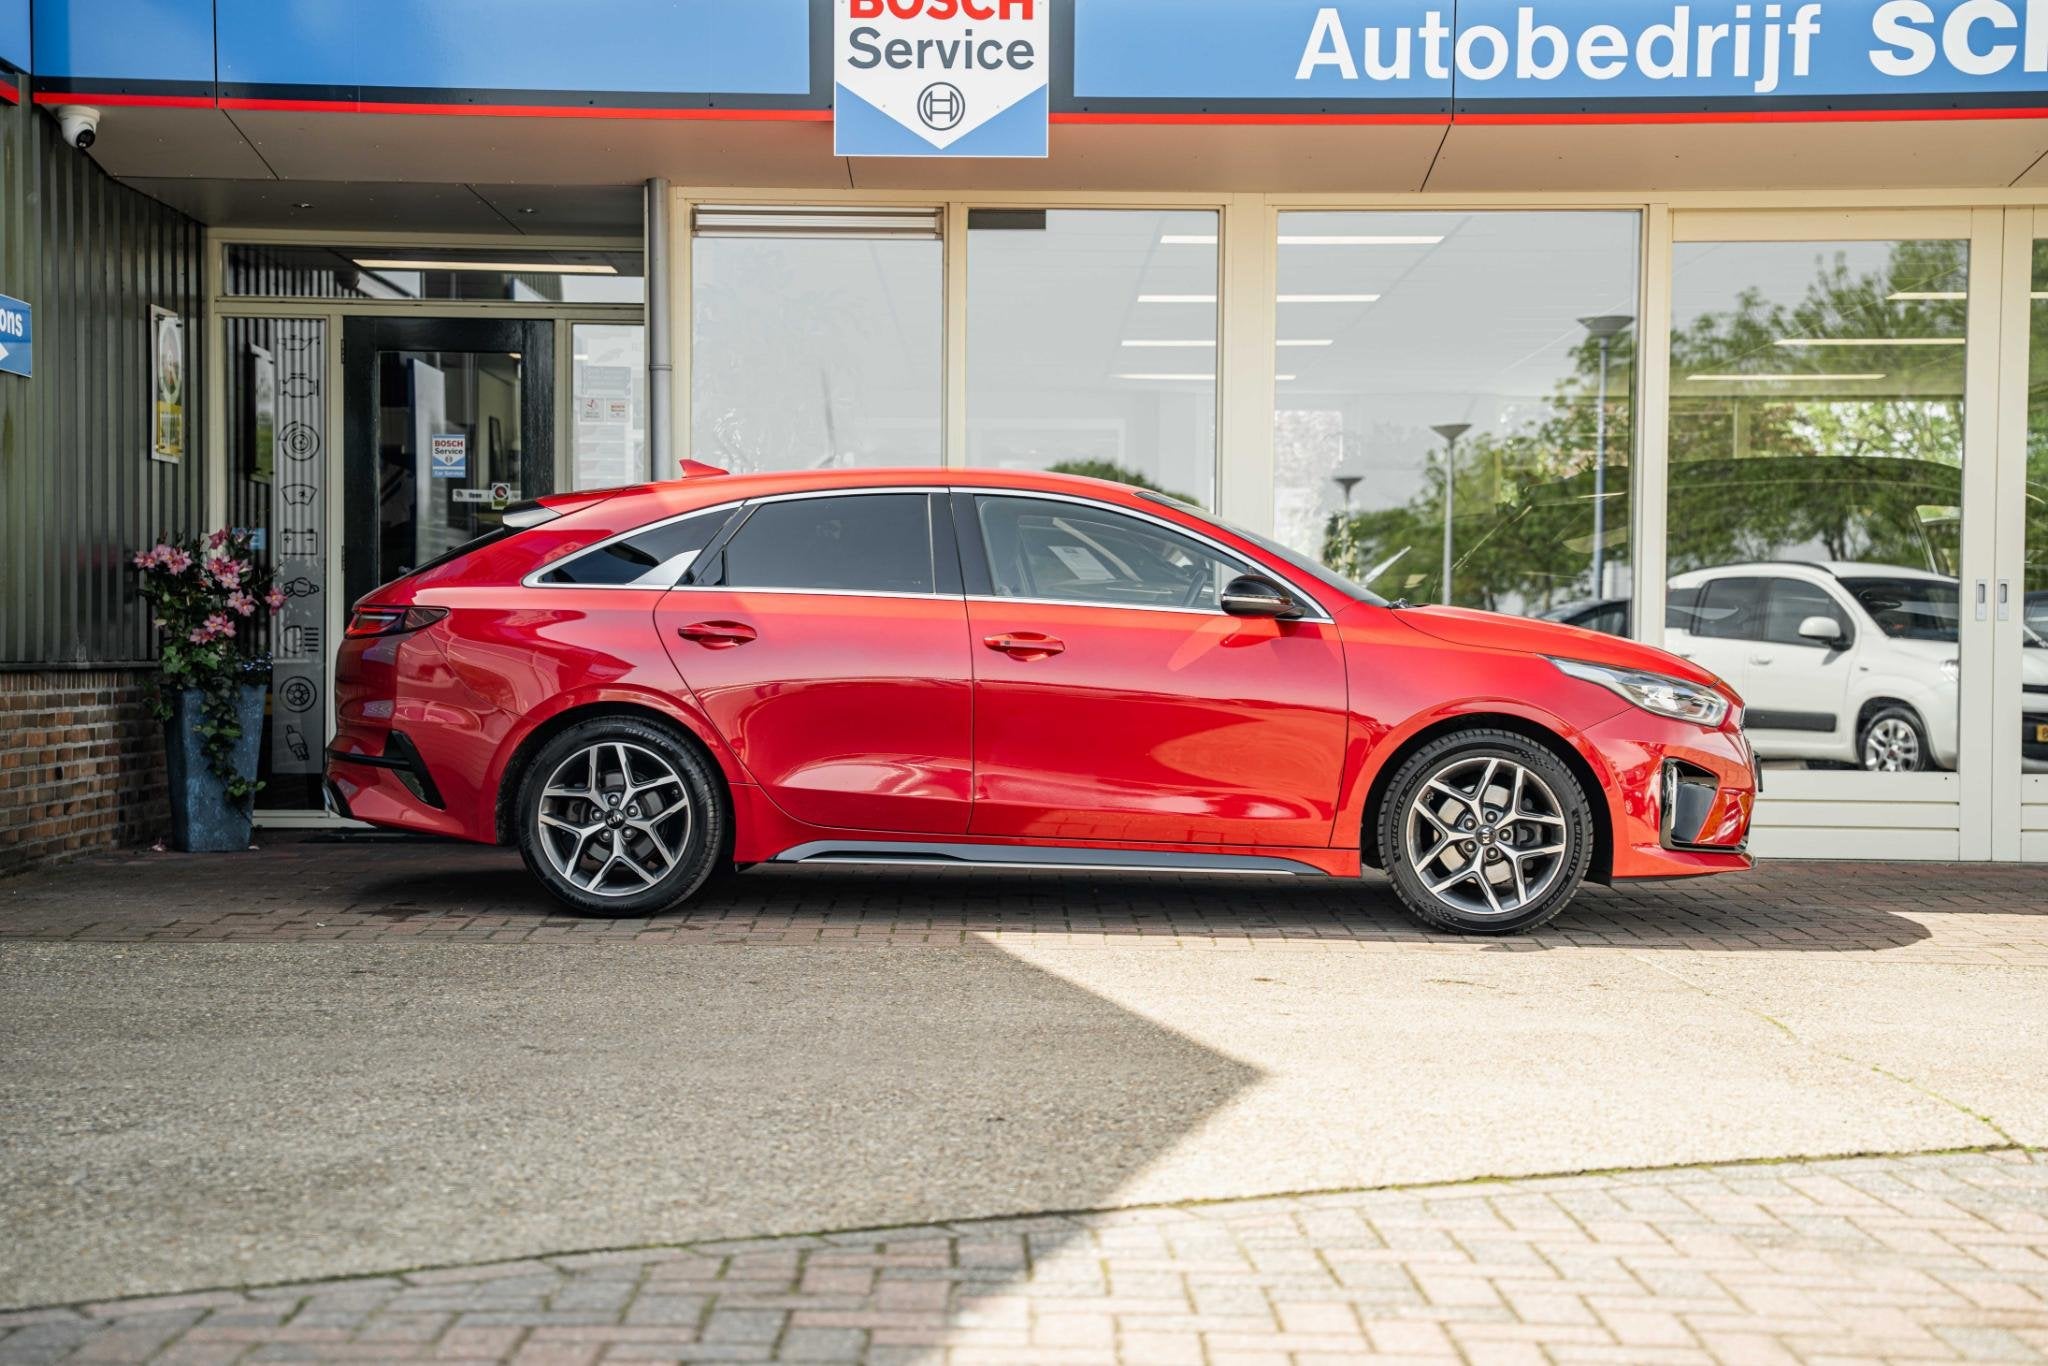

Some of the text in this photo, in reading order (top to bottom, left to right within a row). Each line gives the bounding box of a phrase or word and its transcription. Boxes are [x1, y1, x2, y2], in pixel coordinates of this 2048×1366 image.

[847, 26, 1035, 70] Service
[1294, 3, 1822, 94] Autobedrijf
[434, 447, 464, 455] Service
[606, 813, 623, 825] KIA
[1391, 794, 1407, 847] MICHELIN
[1482, 827, 1490, 844] KIA
[1566, 824, 1582, 877] MICHELIN
